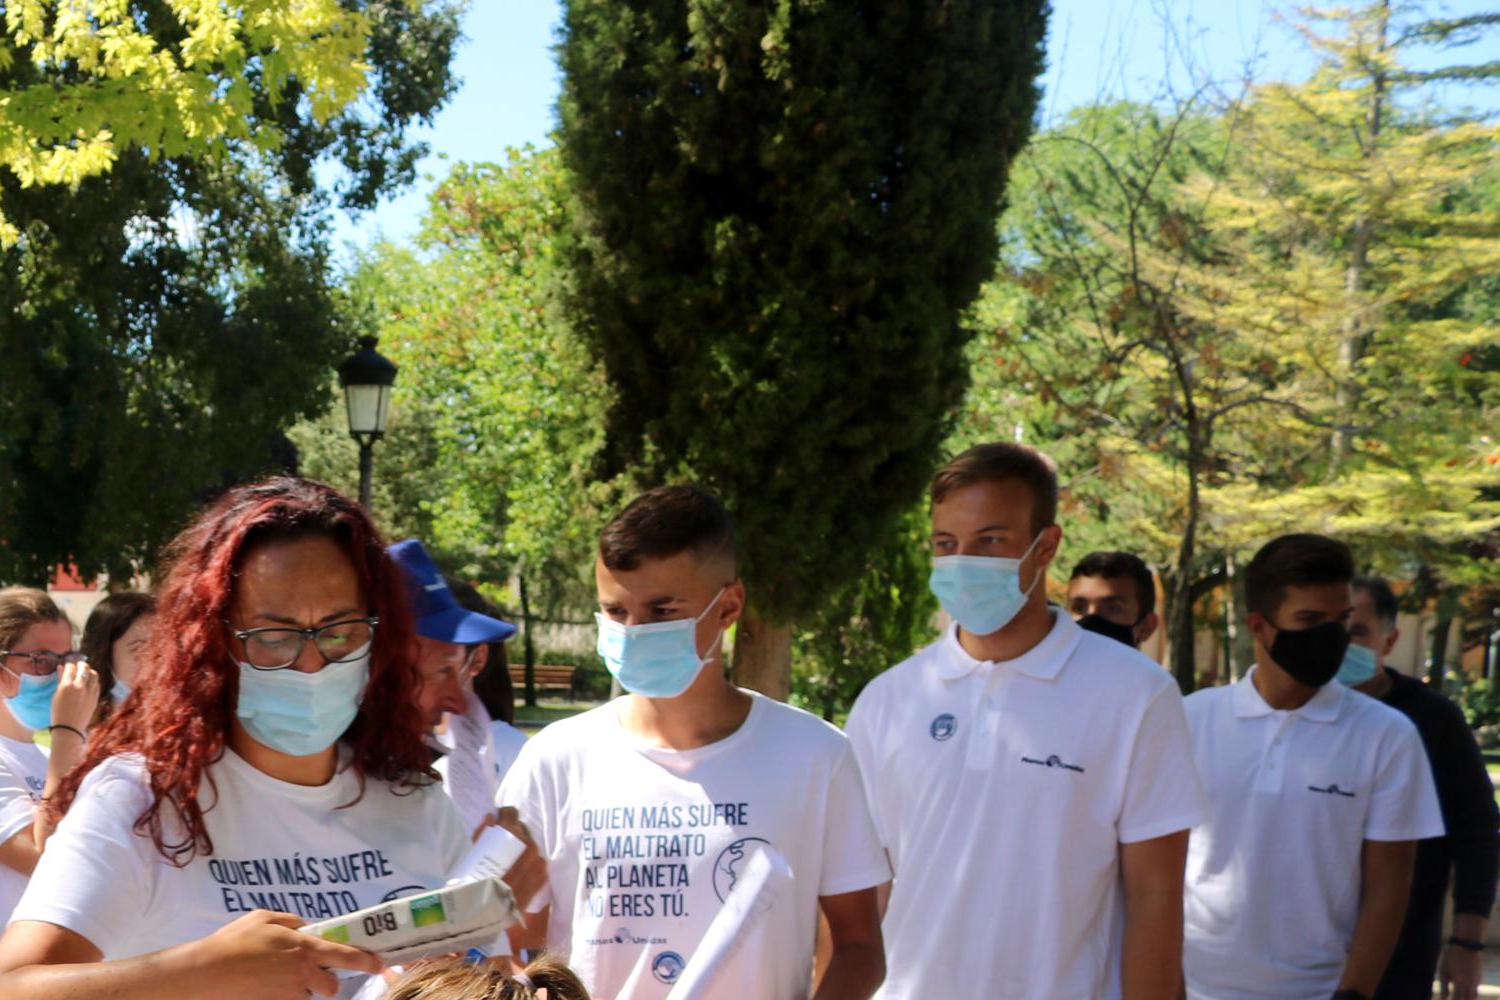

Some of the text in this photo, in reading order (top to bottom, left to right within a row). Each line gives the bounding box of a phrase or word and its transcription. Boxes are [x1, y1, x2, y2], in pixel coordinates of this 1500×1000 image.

[582, 802, 749, 832] QUIEN MÁS SUFRE
[583, 833, 706, 860] EL MALTRATO
[208, 849, 393, 886] QUIEN MÁS SUFRE
[585, 864, 690, 889] AL PLANETA
[221, 888, 248, 913] EL
[587, 889, 689, 918] NO ERES TÚ.
